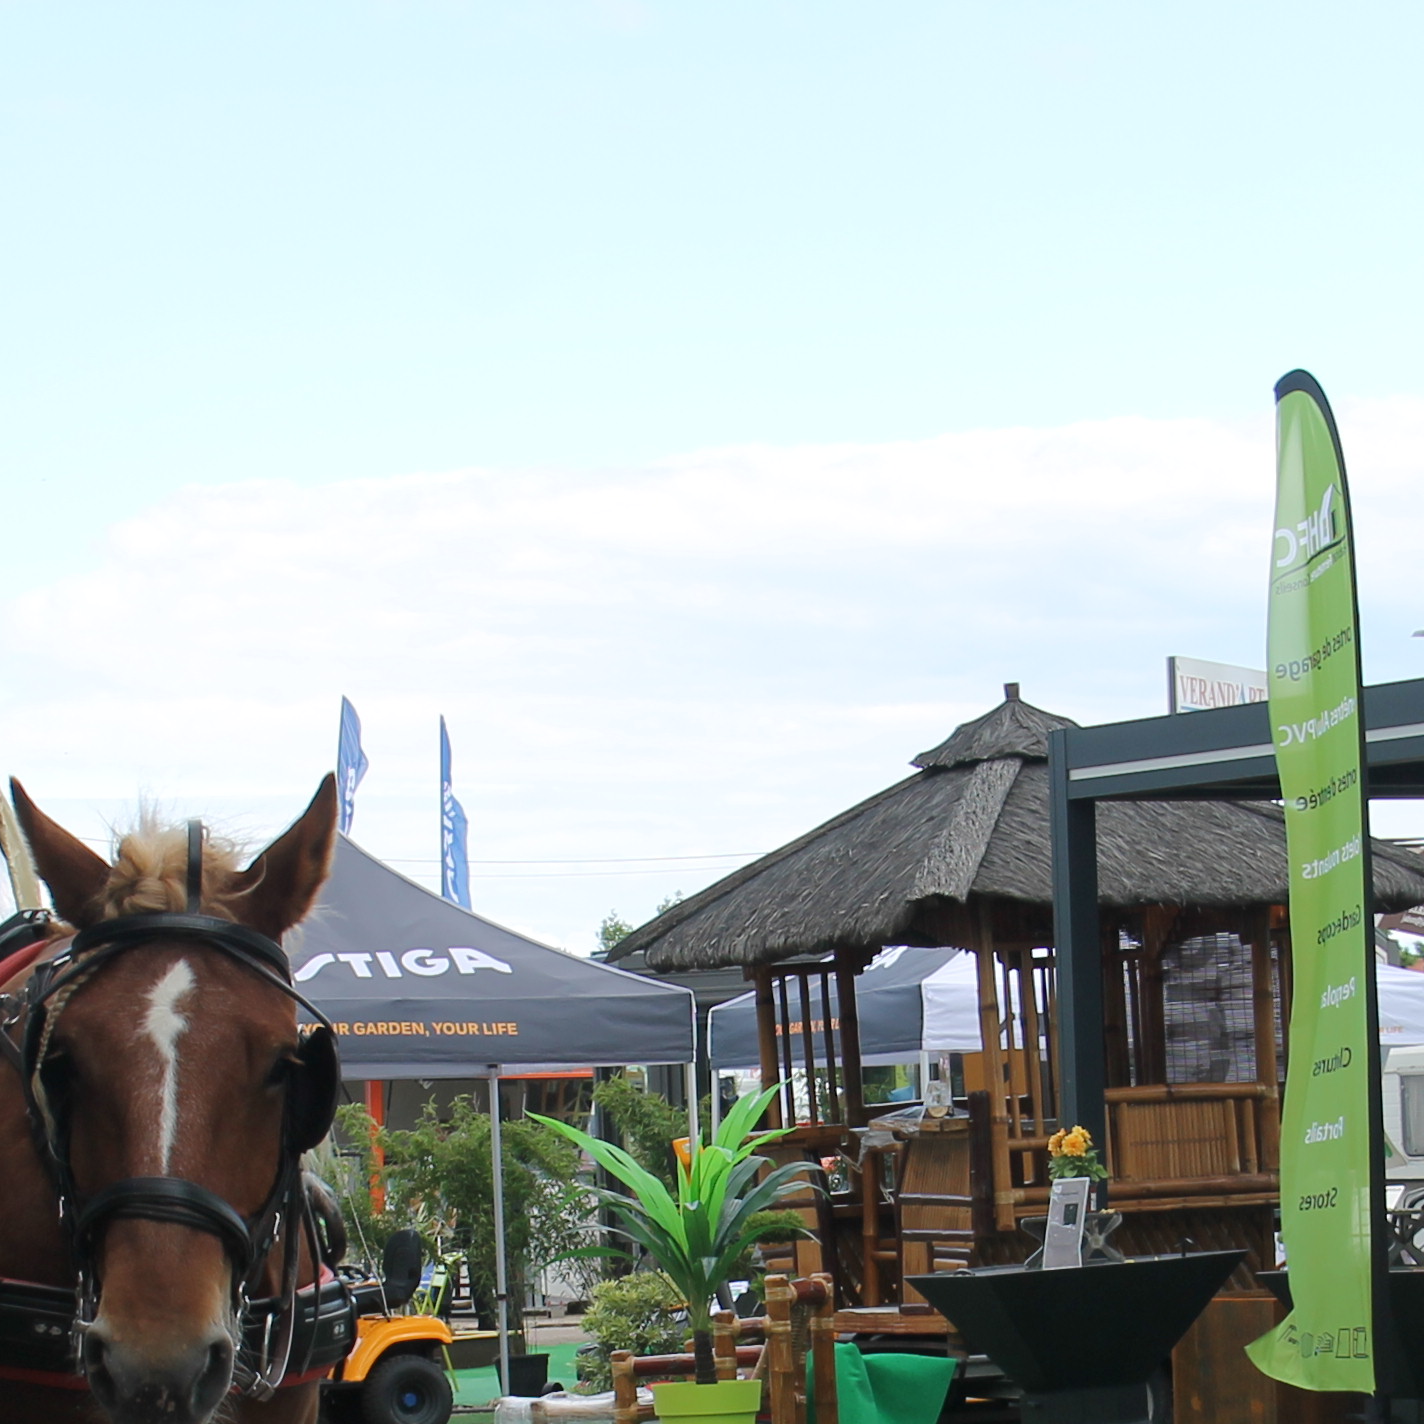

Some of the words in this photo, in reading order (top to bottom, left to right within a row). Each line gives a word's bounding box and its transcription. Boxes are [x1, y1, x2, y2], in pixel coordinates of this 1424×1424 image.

[293, 946, 513, 982] STIGA
[352, 1021, 430, 1038] GARDEN,
[432, 1021, 480, 1036] YOUR
[483, 1021, 519, 1036] LIFE
